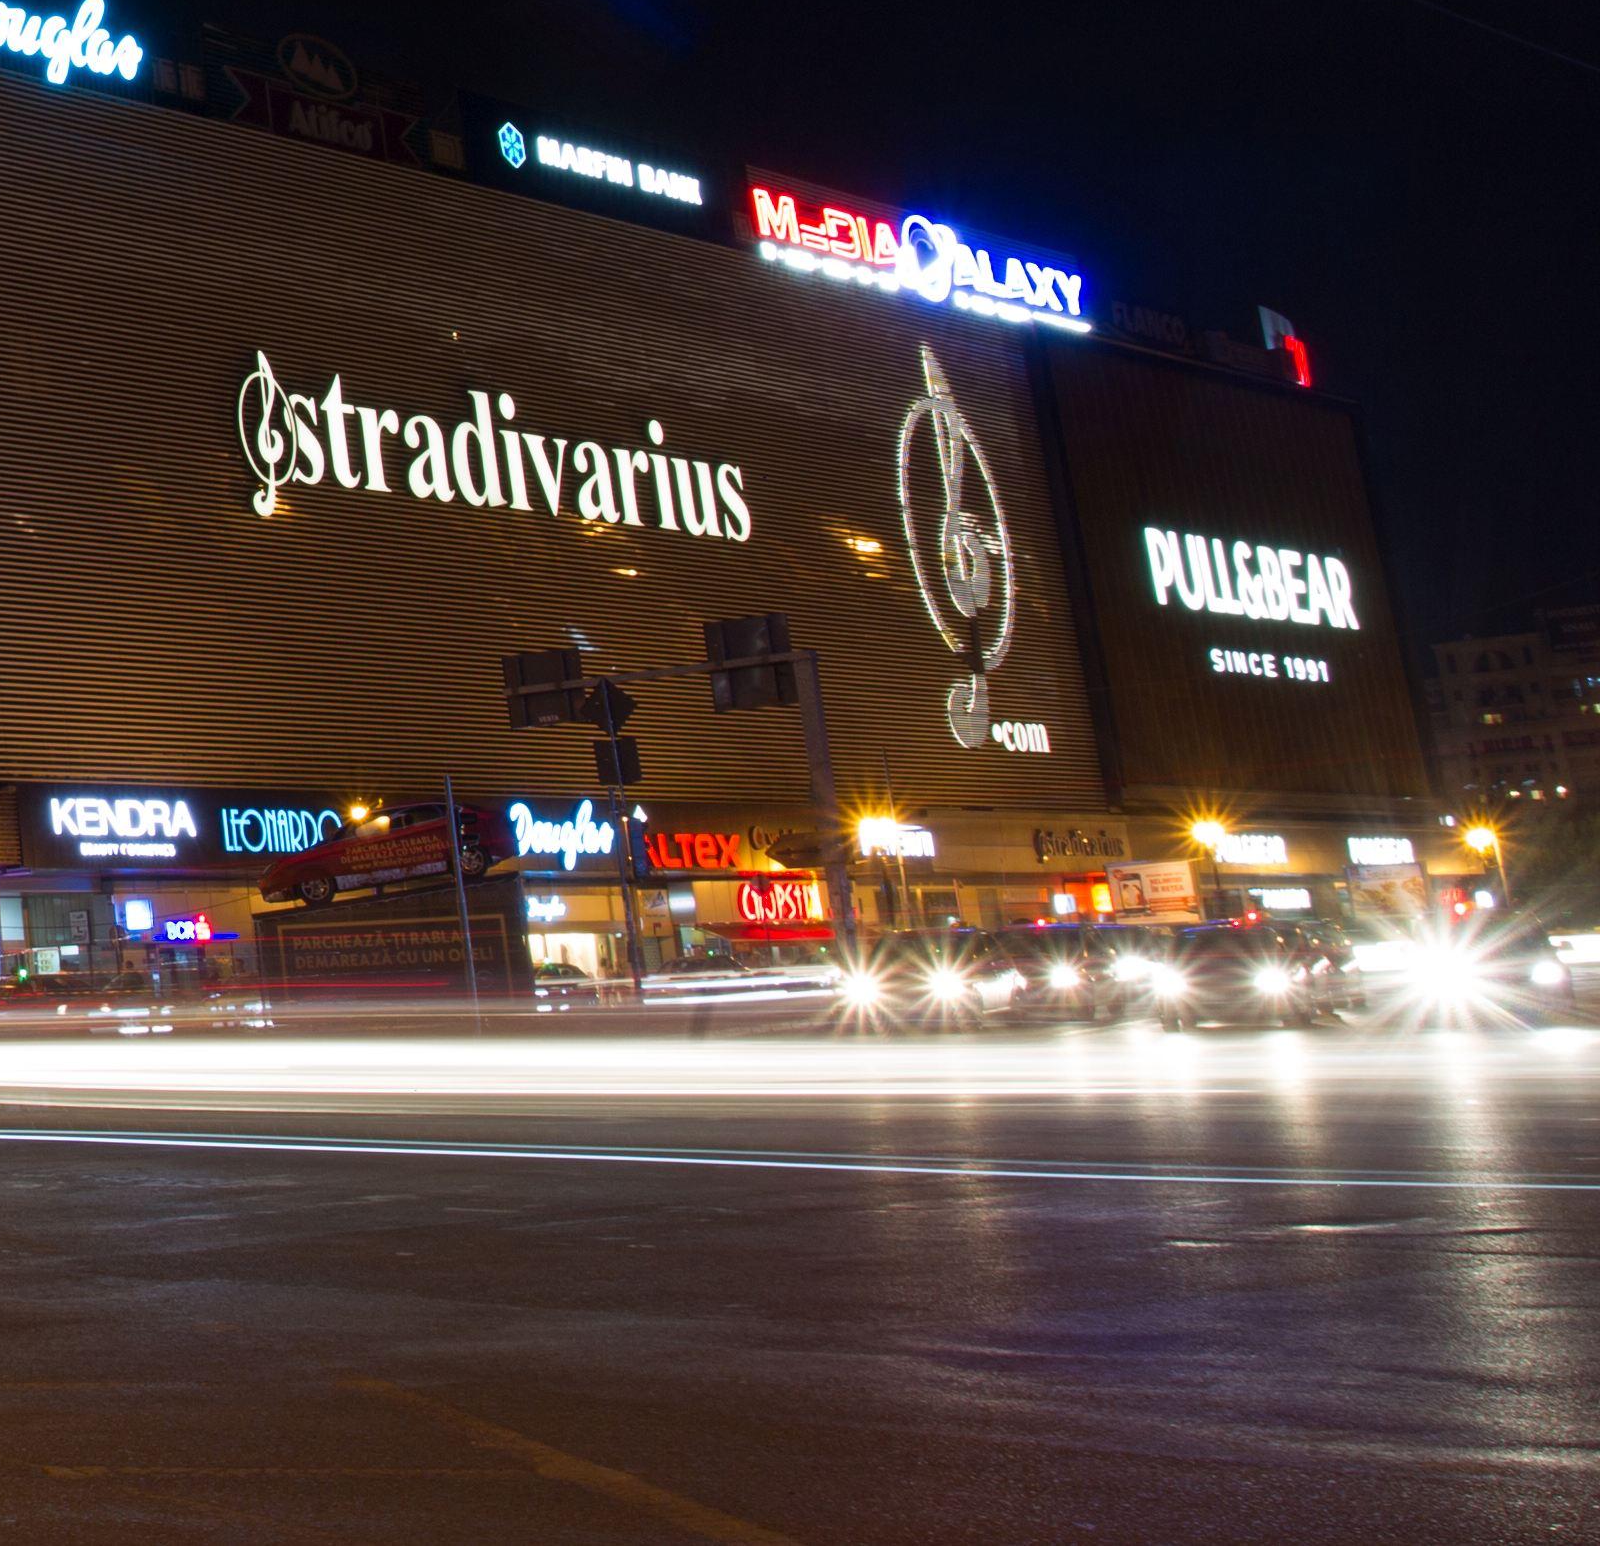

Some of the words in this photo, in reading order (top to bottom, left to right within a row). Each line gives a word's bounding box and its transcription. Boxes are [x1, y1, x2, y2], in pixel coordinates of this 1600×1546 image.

[537, 135, 633, 188] MARFIN
[638, 162, 702, 206] BANK
[284, 373, 752, 542] stradivarius
[1145, 526, 1360, 630] PULL&BEAR
[1210, 648, 1278, 678] SINCE
[1284, 656, 1330, 683] 1991
[51, 797, 196, 838] KENDRA
[222, 807, 343, 852] LEONARDO
[396, 951, 419, 965] CU
[422, 949, 445, 963] UN
[448, 946, 494, 962] OEL!
